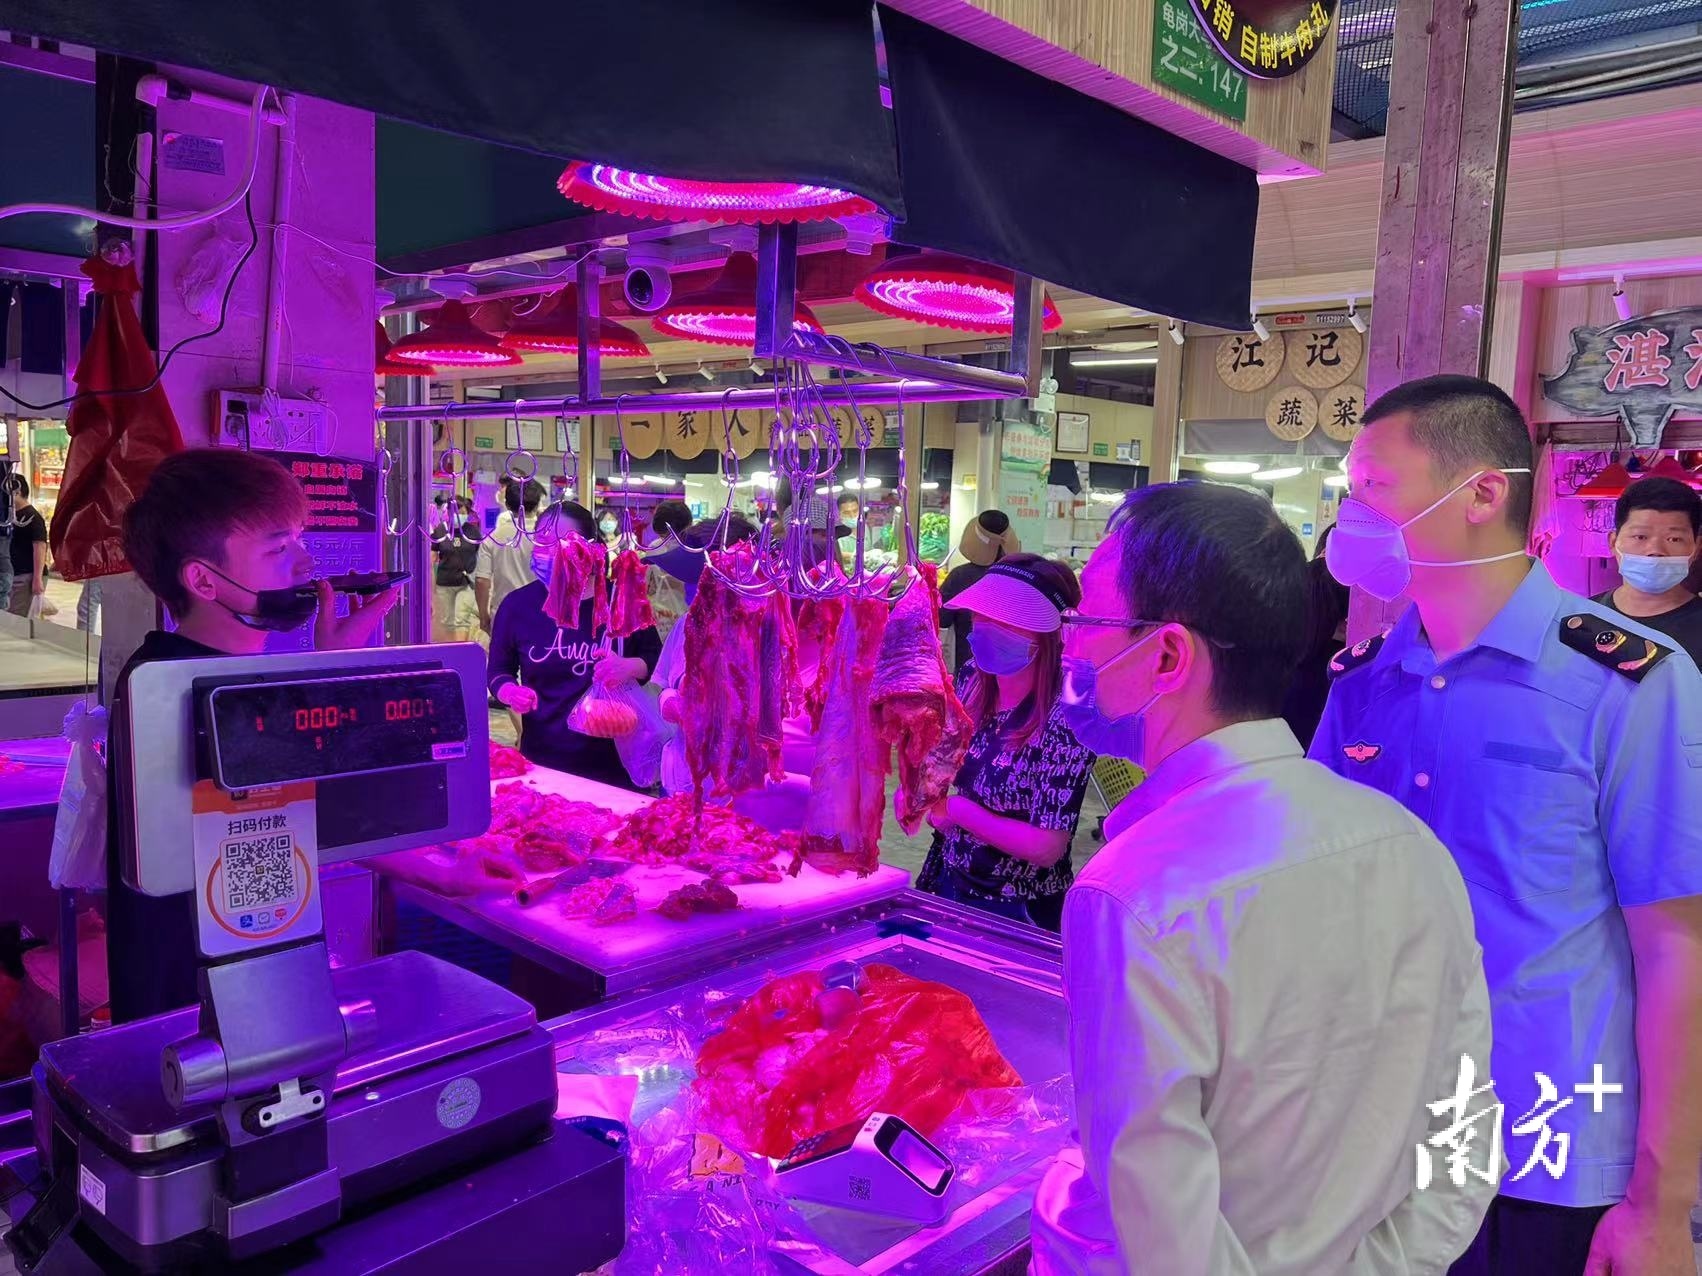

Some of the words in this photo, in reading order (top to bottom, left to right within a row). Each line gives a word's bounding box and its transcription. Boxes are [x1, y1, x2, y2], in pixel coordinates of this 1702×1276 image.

[1232, 331, 1341, 373] 江记
[631, 409, 749, 440] 一家人
[1277, 397, 1357, 427] 蔬菜
[228, 814, 287, 835] 扫码付款
